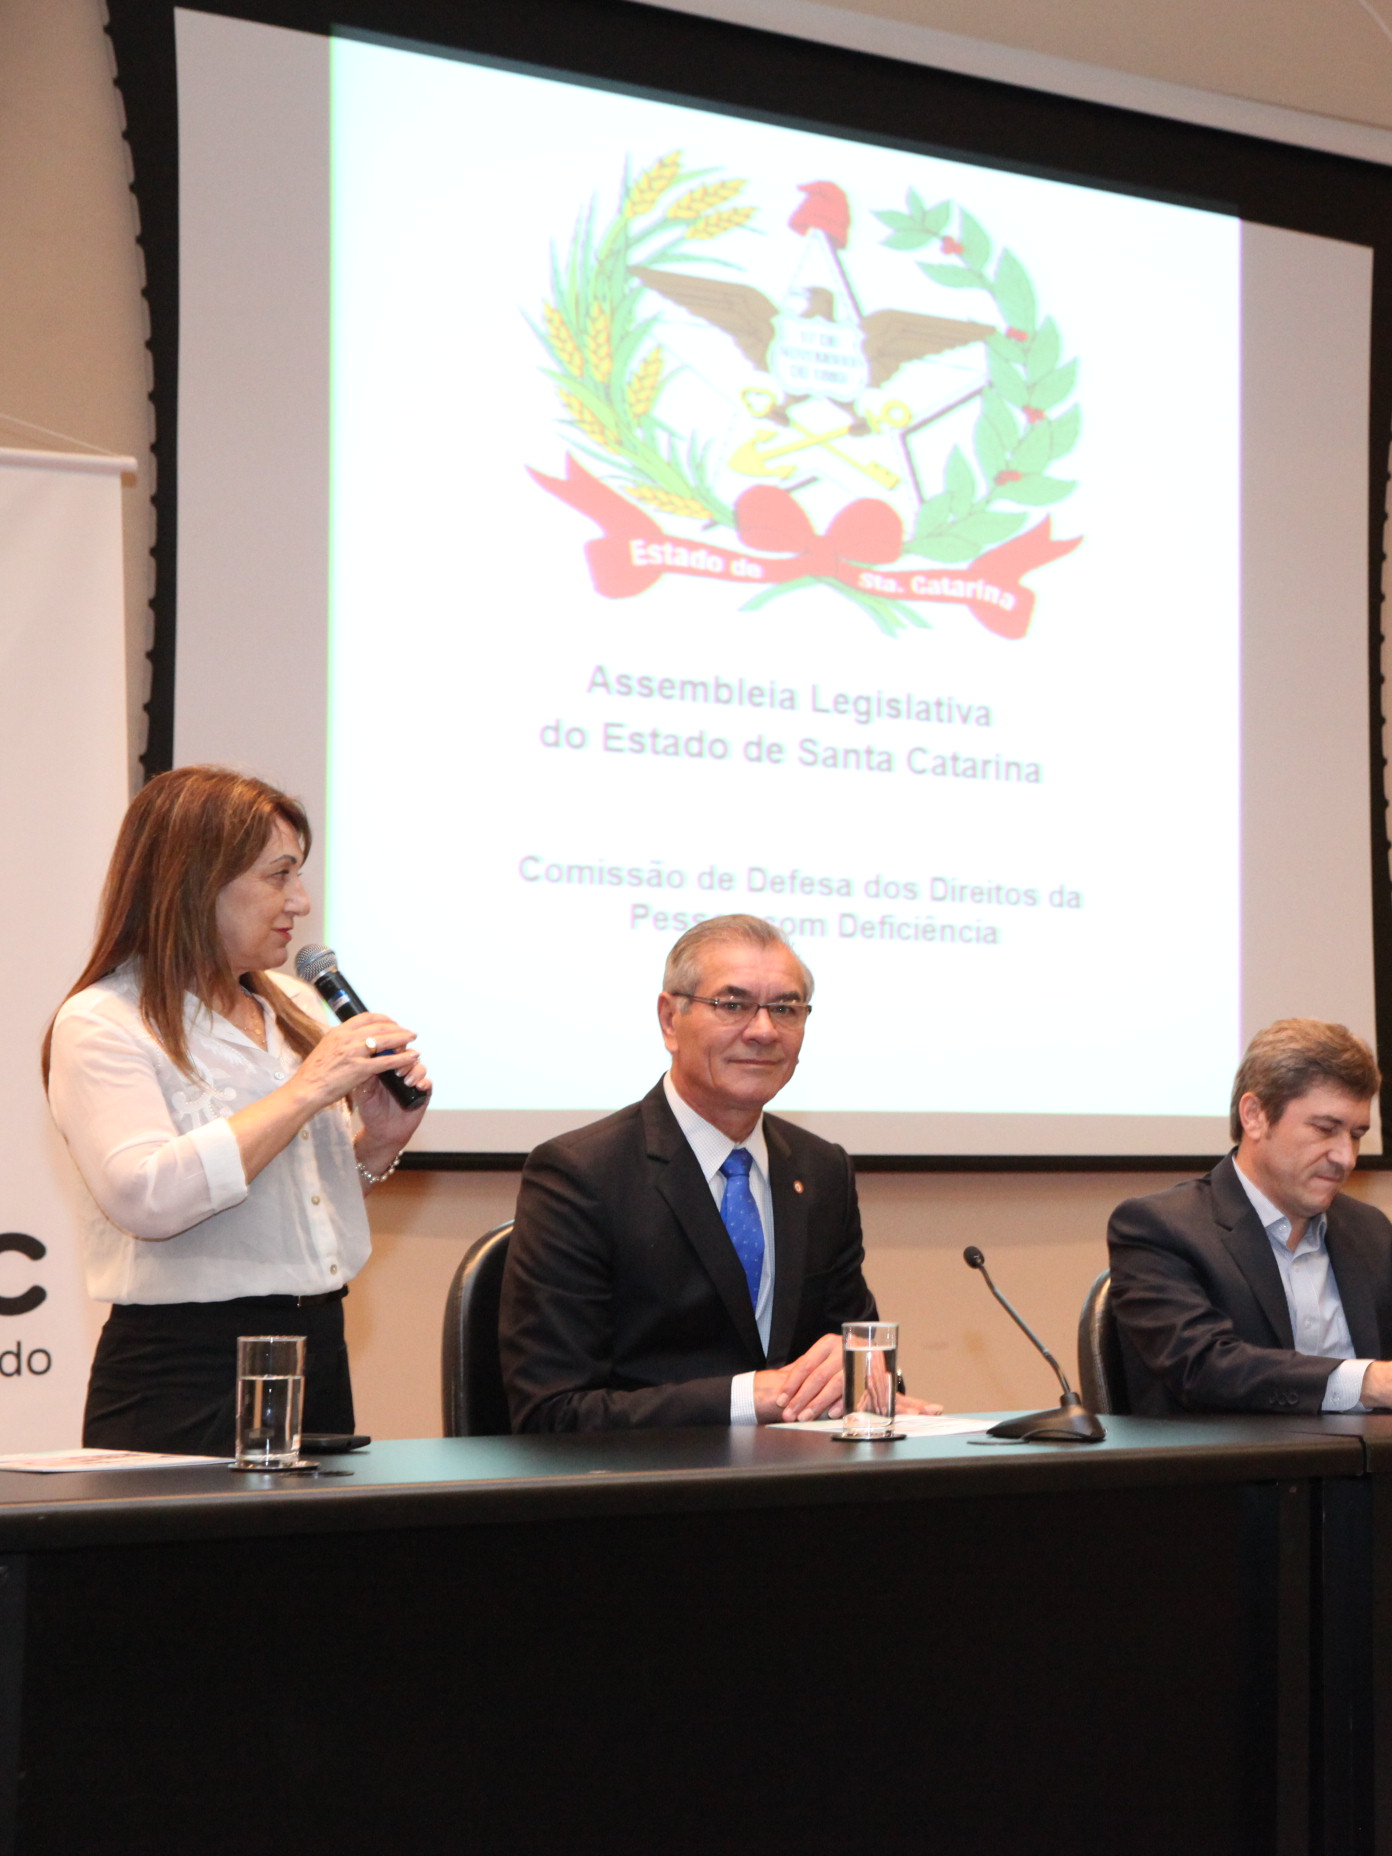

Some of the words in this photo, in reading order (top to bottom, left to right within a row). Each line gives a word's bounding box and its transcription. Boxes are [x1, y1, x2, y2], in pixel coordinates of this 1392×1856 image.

[629, 539, 725, 573] Estado
[730, 558, 765, 580] de
[857, 571, 904, 595] Sta.
[910, 575, 1017, 612] Catarina
[587, 665, 798, 711] Assembleia
[811, 684, 993, 727] Legislativa
[539, 720, 588, 749] do
[602, 722, 729, 760] Estado
[743, 735, 784, 764] de
[798, 738, 894, 774] Santa
[906, 747, 1043, 784] Catarina
[519, 855, 685, 890] Comissão
[697, 863, 735, 893] de
[747, 866, 852, 898] Defesa
[864, 873, 919, 902] dos
[930, 877, 1038, 908] Direitos
[1049, 886, 1083, 910] da
[838, 912, 1000, 946] Deficiência
